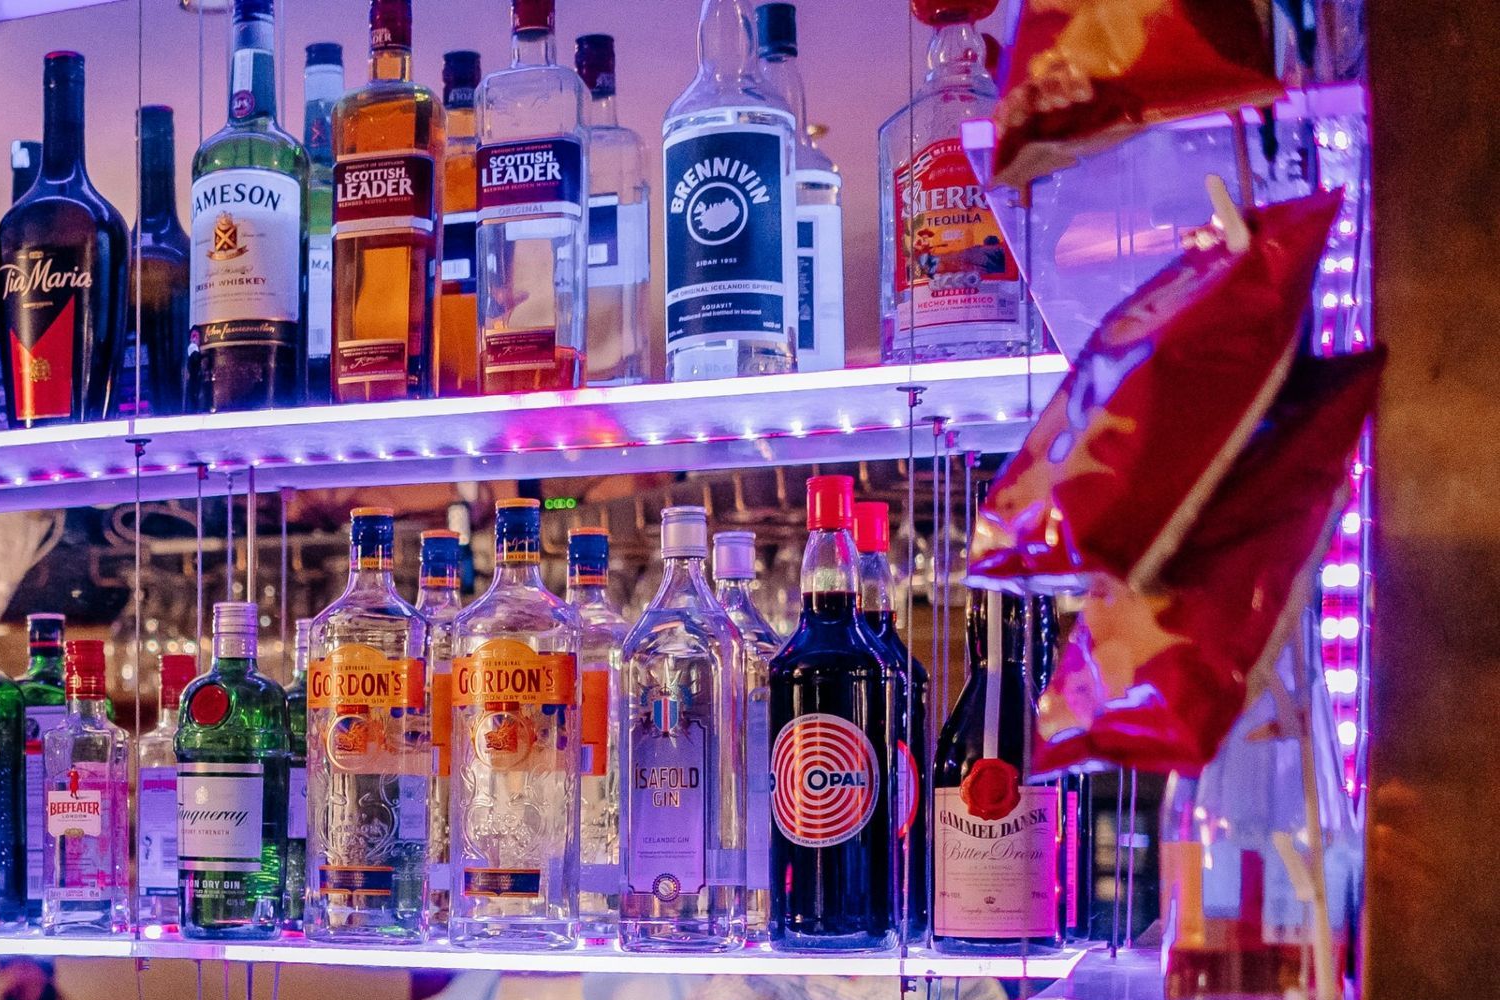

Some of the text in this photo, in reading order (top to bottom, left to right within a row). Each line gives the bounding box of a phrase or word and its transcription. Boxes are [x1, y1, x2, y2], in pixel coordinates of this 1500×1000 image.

[489, 151, 554, 168] SCOTTISH
[933, 144, 962, 156] MEXIC
[345, 167, 408, 184] SCOTTISH
[481, 161, 562, 187] LEADER
[193, 183, 281, 217] AMESON
[337, 178, 414, 202] LEADER
[902, 181, 988, 219] SIERR
[498, 204, 544, 216] ORIGINAL
[927, 213, 982, 226] TEQUILA
[23, 258, 92, 297] Maria
[219, 277, 267, 288] WHISKEY
[918, 301, 945, 309] HECHO
[947, 299, 958, 307] EN
[312, 670, 402, 698] GORDON'S
[458, 666, 555, 696] GORDON'S
[635, 765, 699, 790] ÍSAFOLD
[807, 769, 865, 791] OPAL
[50, 802, 100, 816] BEEFEATER
[653, 791, 680, 808] GIN
[178, 803, 249, 827] anqueray
[939, 807, 1048, 840] GAMMEL DANSK
[943, 838, 989, 861] Bitter
[202, 880, 241, 890] DRY GIN
